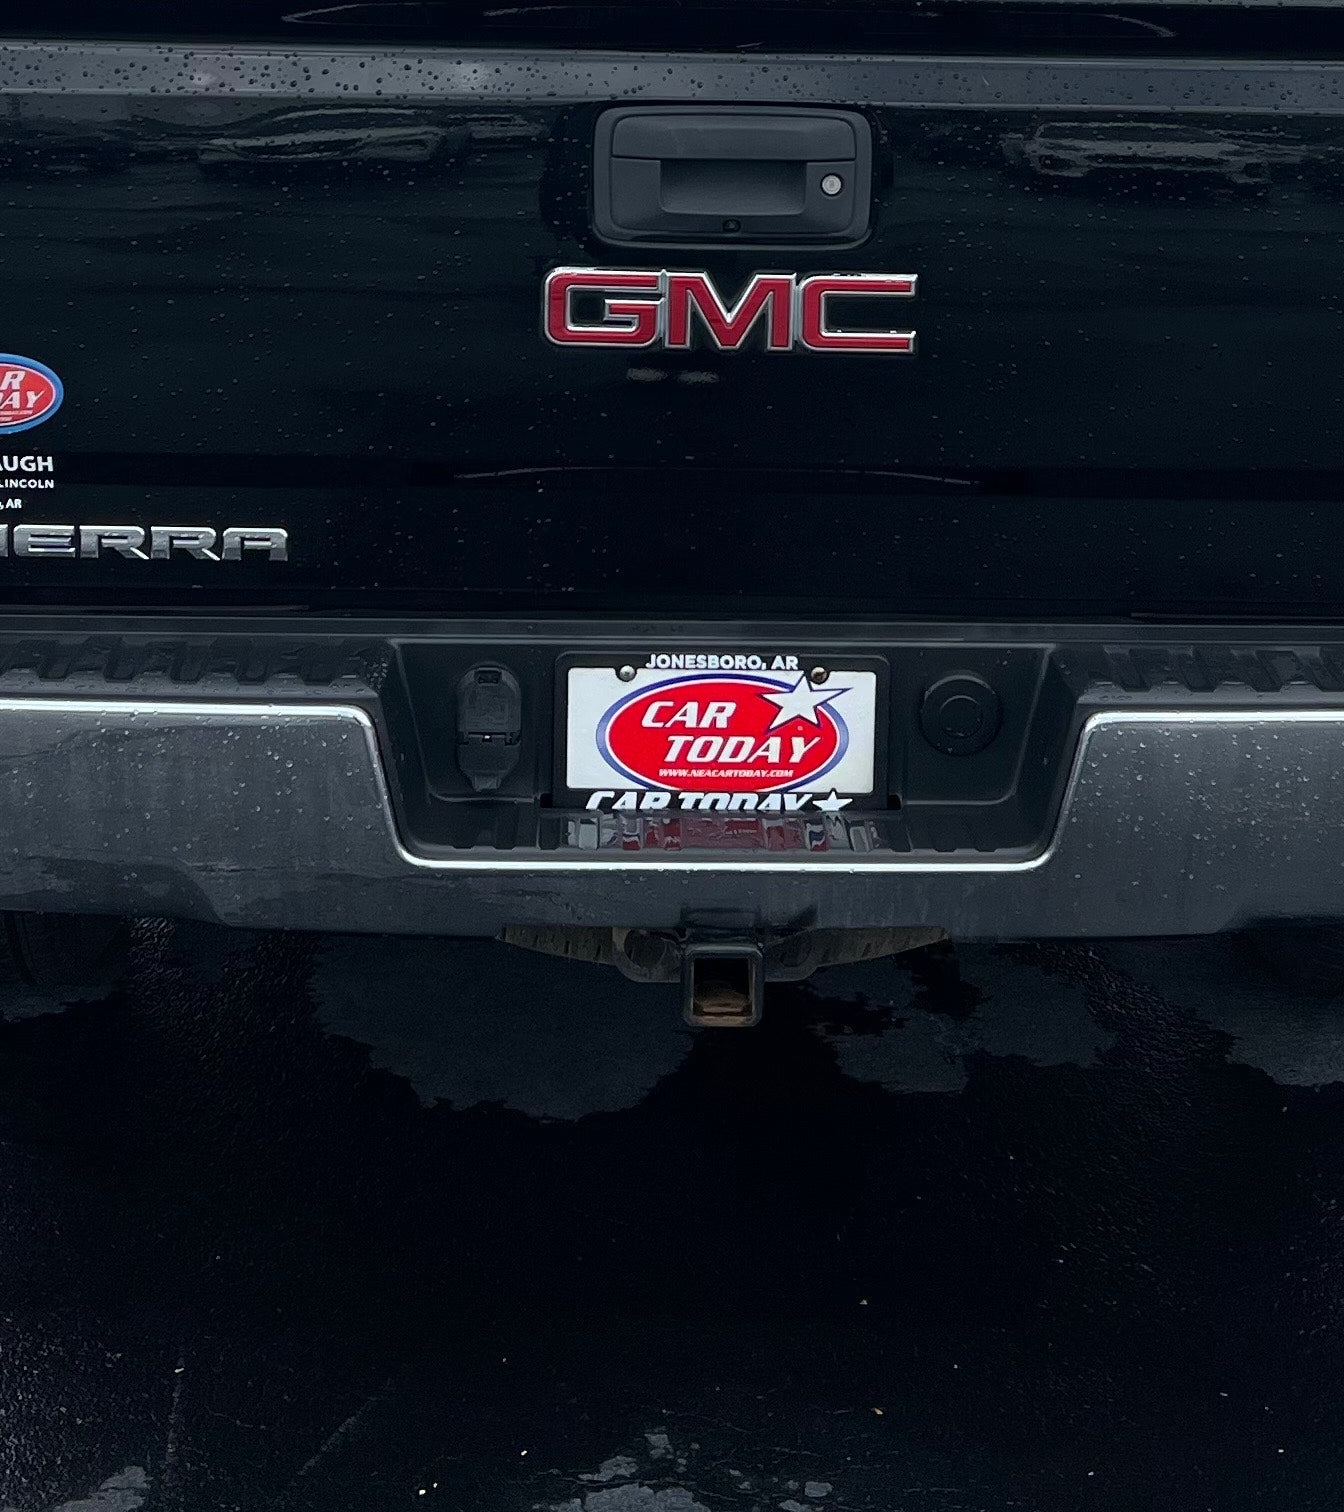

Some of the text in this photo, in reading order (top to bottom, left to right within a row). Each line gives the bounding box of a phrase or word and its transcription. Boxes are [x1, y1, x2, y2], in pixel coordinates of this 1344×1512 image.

[545, 267, 917, 354] GMC
[5, 499, 22, 509] AR
[646, 654, 798, 670] JONESBORO, AR
[641, 701, 737, 729] CAR
[664, 736, 821, 765] TODAY
[658, 769, 794, 778] WWW.NEACARTODAY.COM
